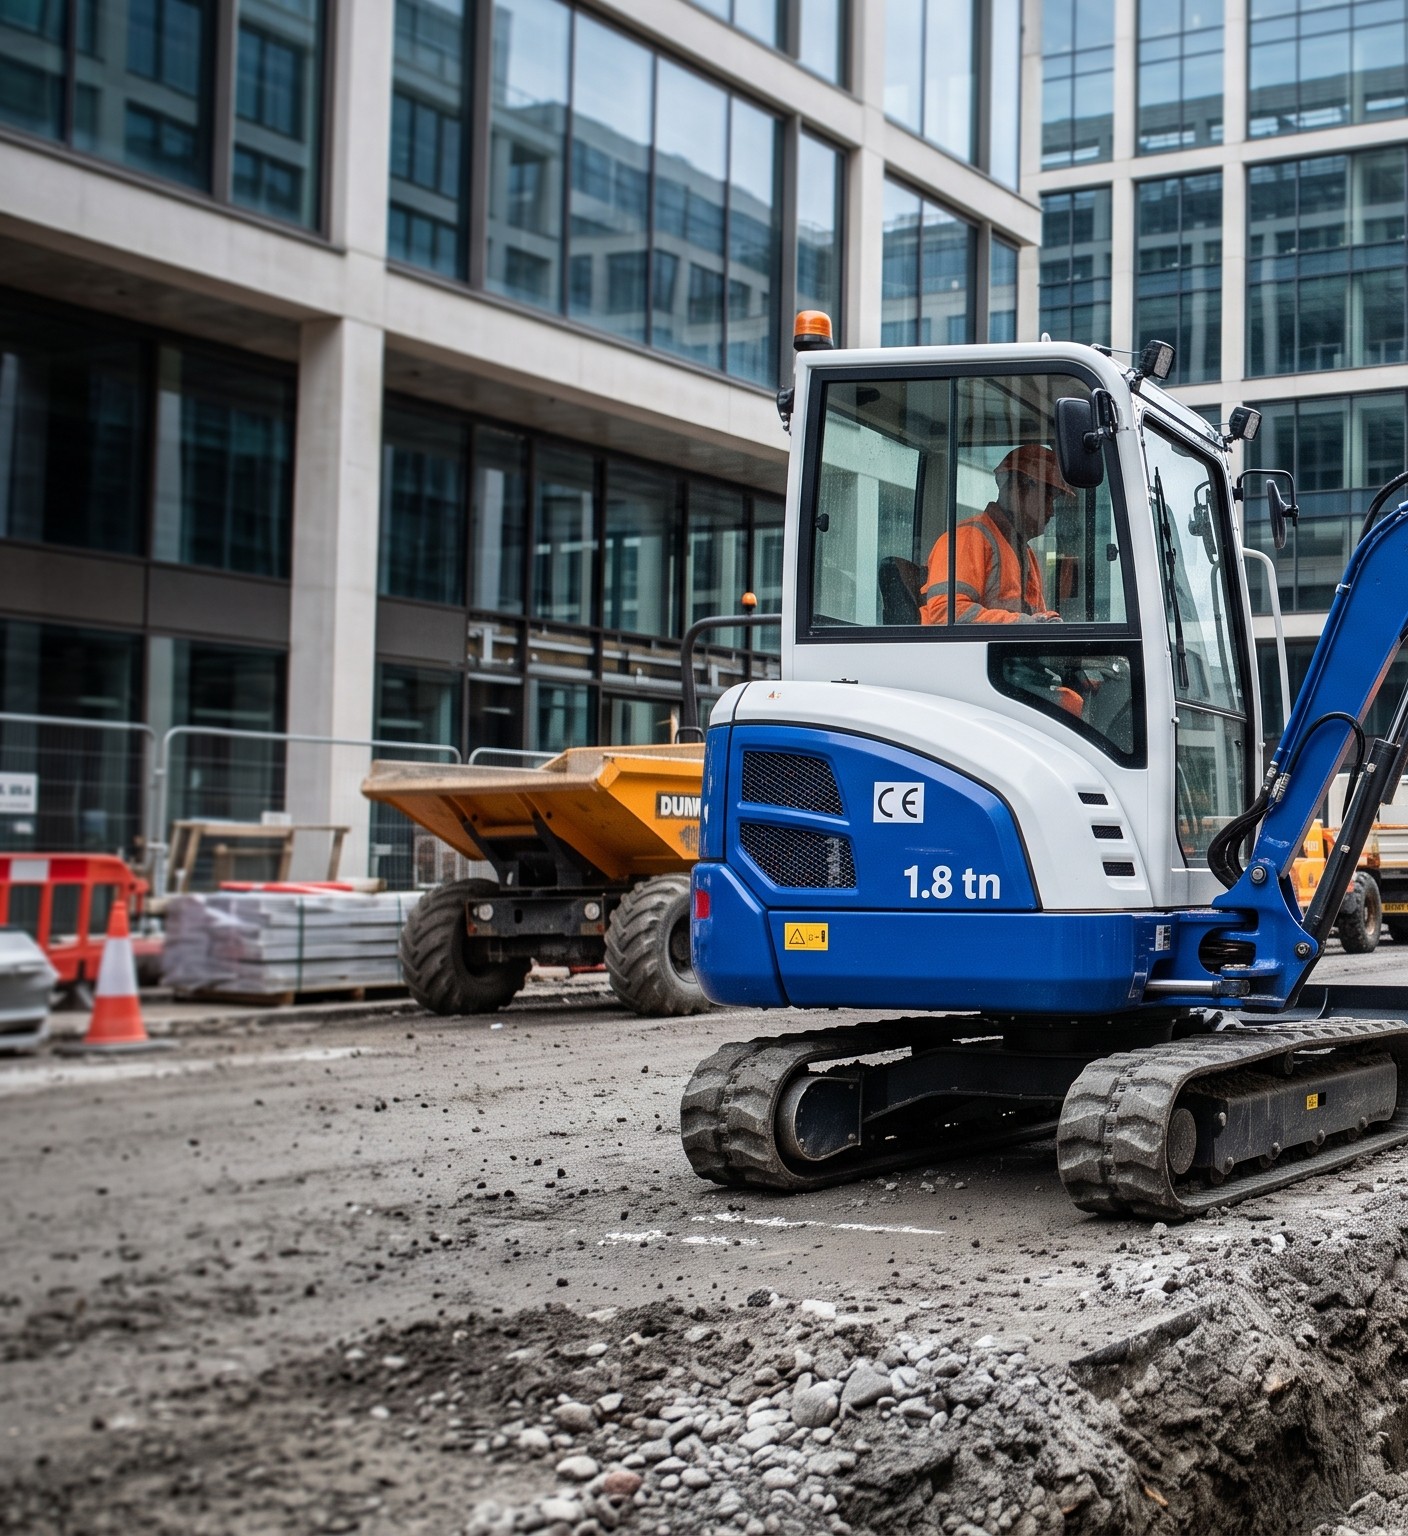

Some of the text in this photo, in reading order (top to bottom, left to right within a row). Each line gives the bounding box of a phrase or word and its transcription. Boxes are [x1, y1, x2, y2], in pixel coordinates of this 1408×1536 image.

[878, 787, 918, 818] CE
[904, 865, 1001, 899] 1.8 tn
